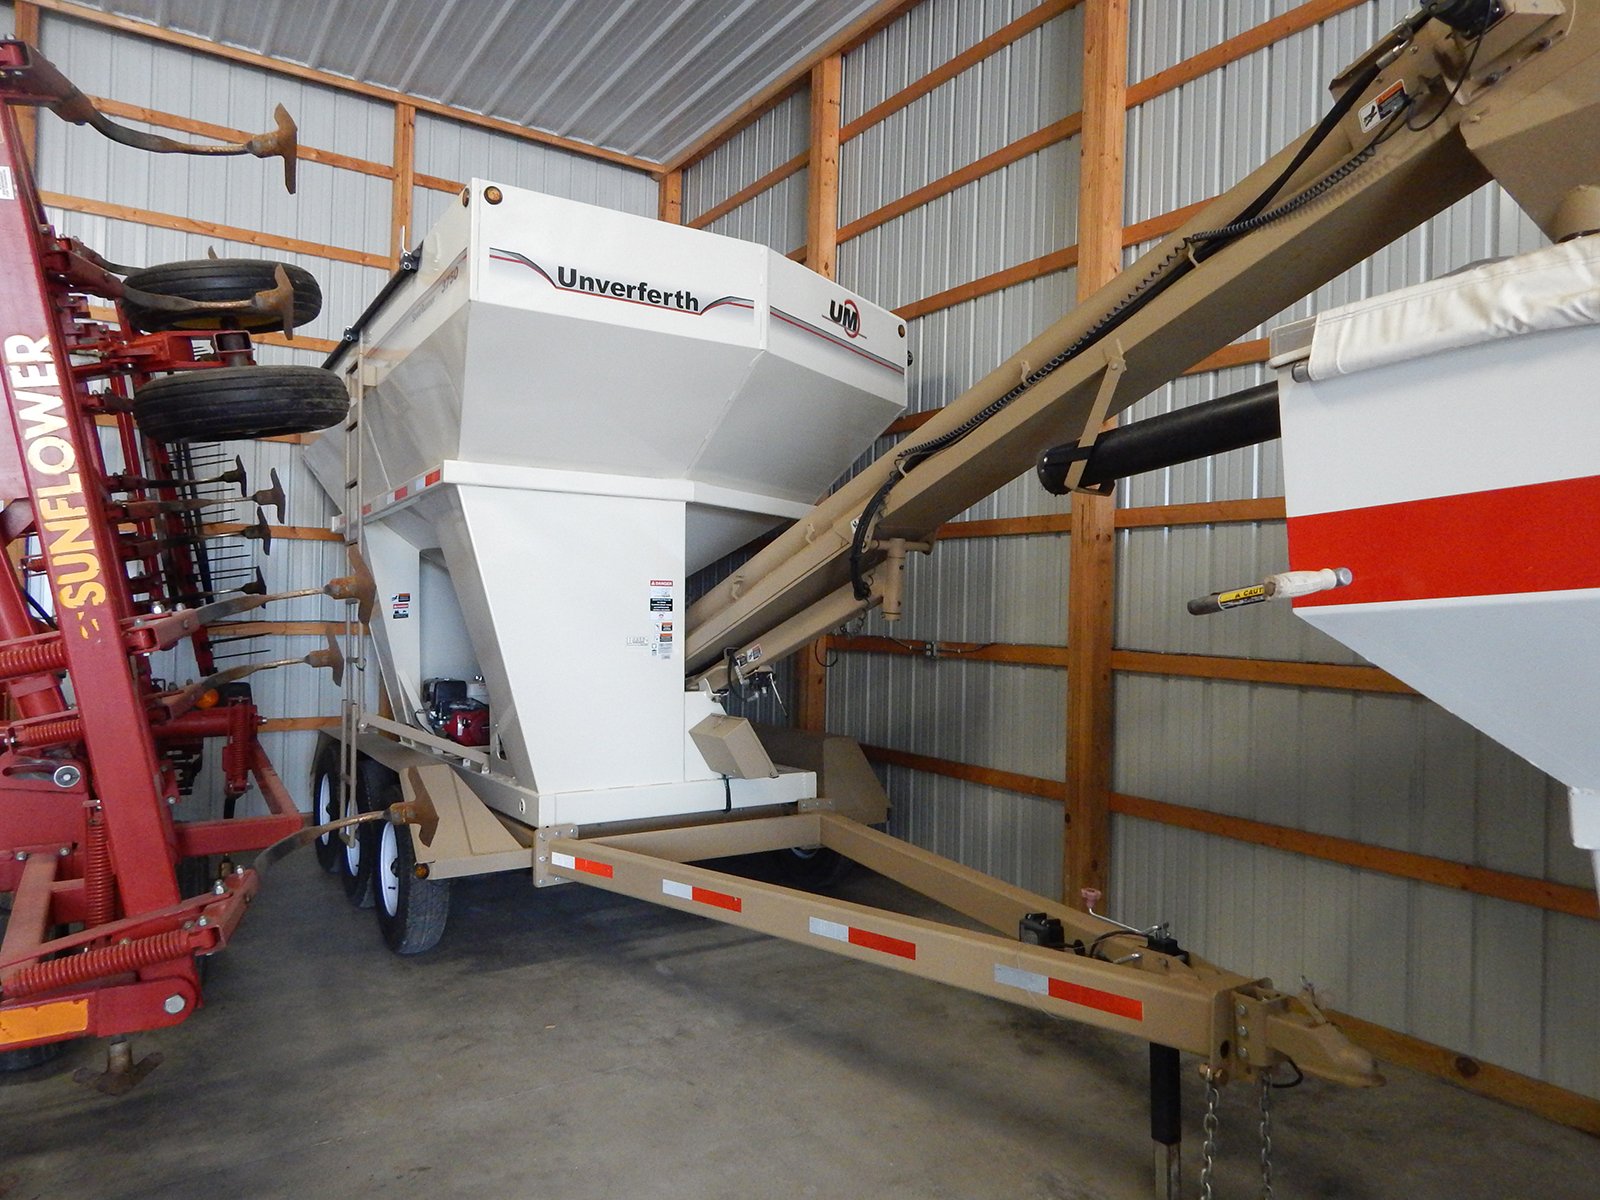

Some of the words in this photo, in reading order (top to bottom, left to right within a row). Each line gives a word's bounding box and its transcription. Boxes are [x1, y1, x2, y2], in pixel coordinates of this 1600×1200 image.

[557, 266, 699, 312] Unverferth
[829, 299, 858, 332] UM
[4, 334, 107, 609] SUNFLOWER
